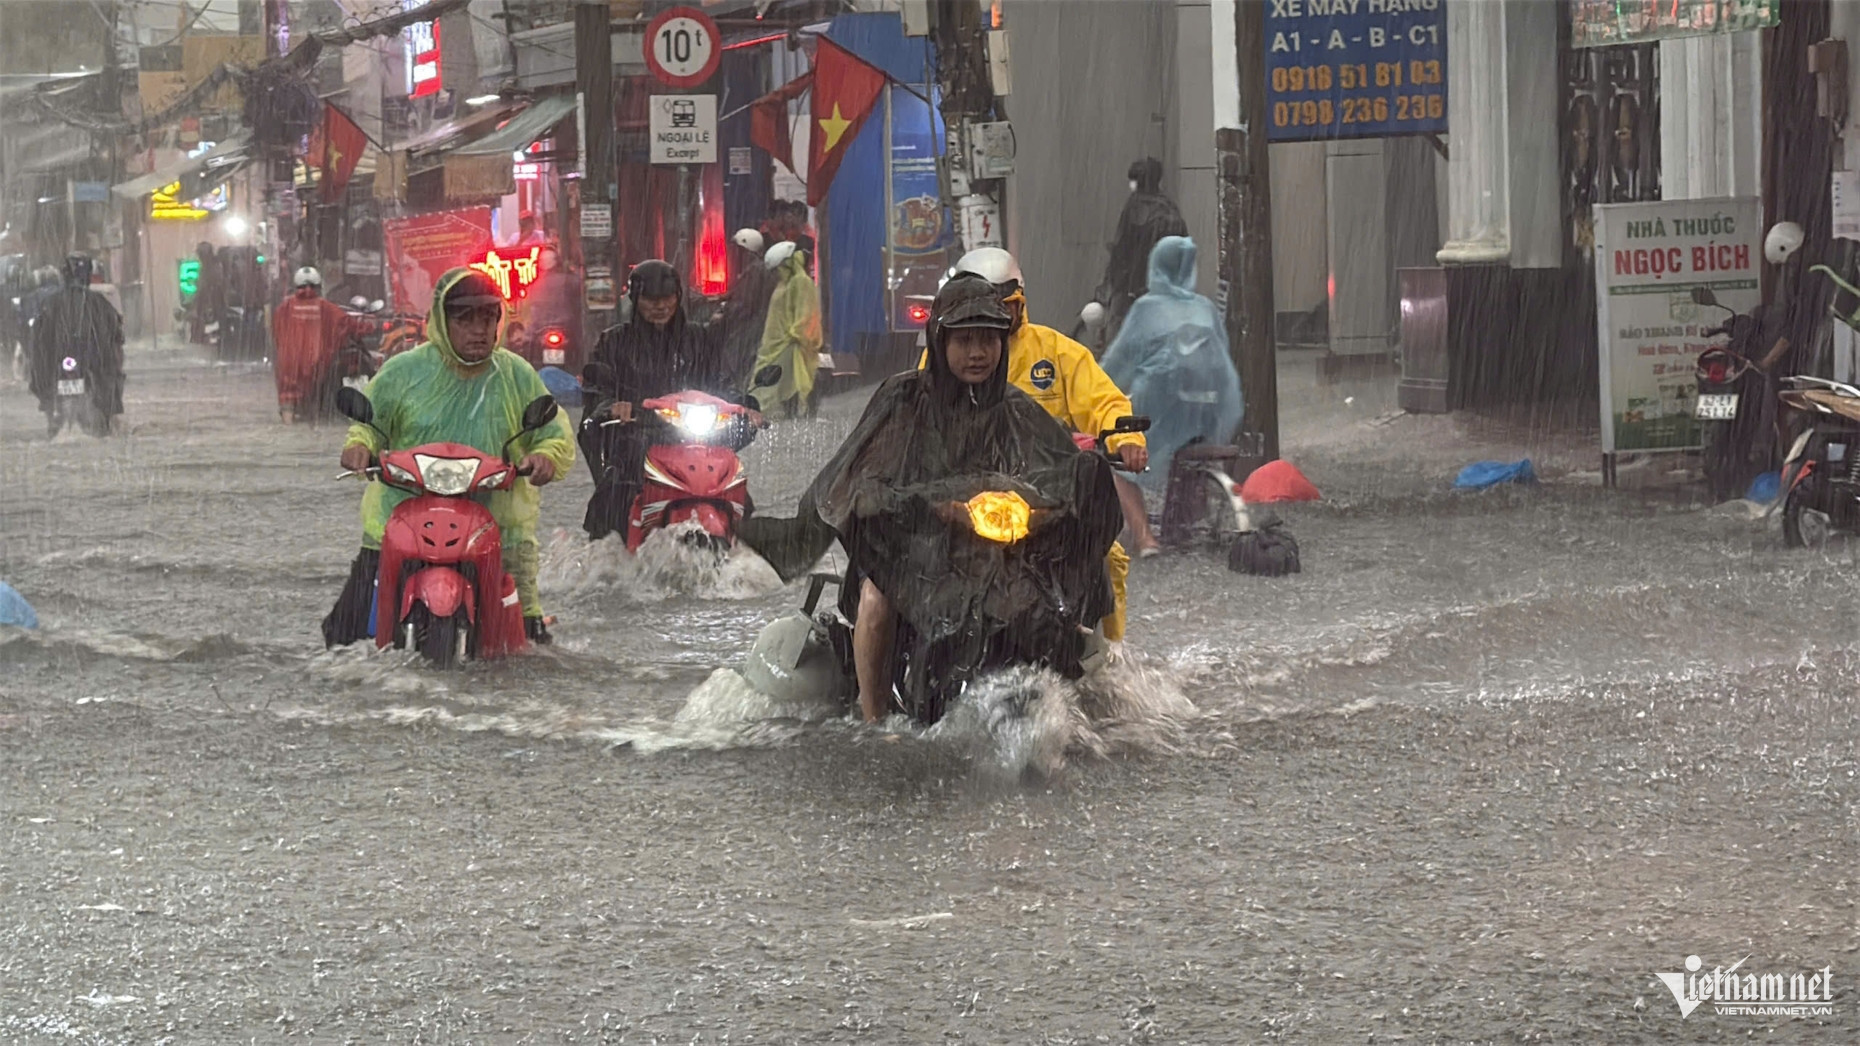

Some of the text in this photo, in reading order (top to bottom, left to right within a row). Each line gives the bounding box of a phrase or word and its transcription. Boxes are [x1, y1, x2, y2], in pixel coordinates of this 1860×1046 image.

[1271, 0, 1301, 17] XE
[662, 29, 702, 63] 10 t
[1272, 31, 1301, 52] A1
[1328, 29, 1346, 49] A
[1369, 27, 1385, 47] B
[1409, 25, 1438, 45] C1
[1340, 63, 1367, 88] 51
[1410, 59, 1441, 85] 03
[1341, 96, 1388, 124] 236
[666, 148, 699, 160] Except
[1627, 211, 1735, 238] NHÀ THUỐC
[1615, 240, 1749, 279] NGỌC BÍCH
